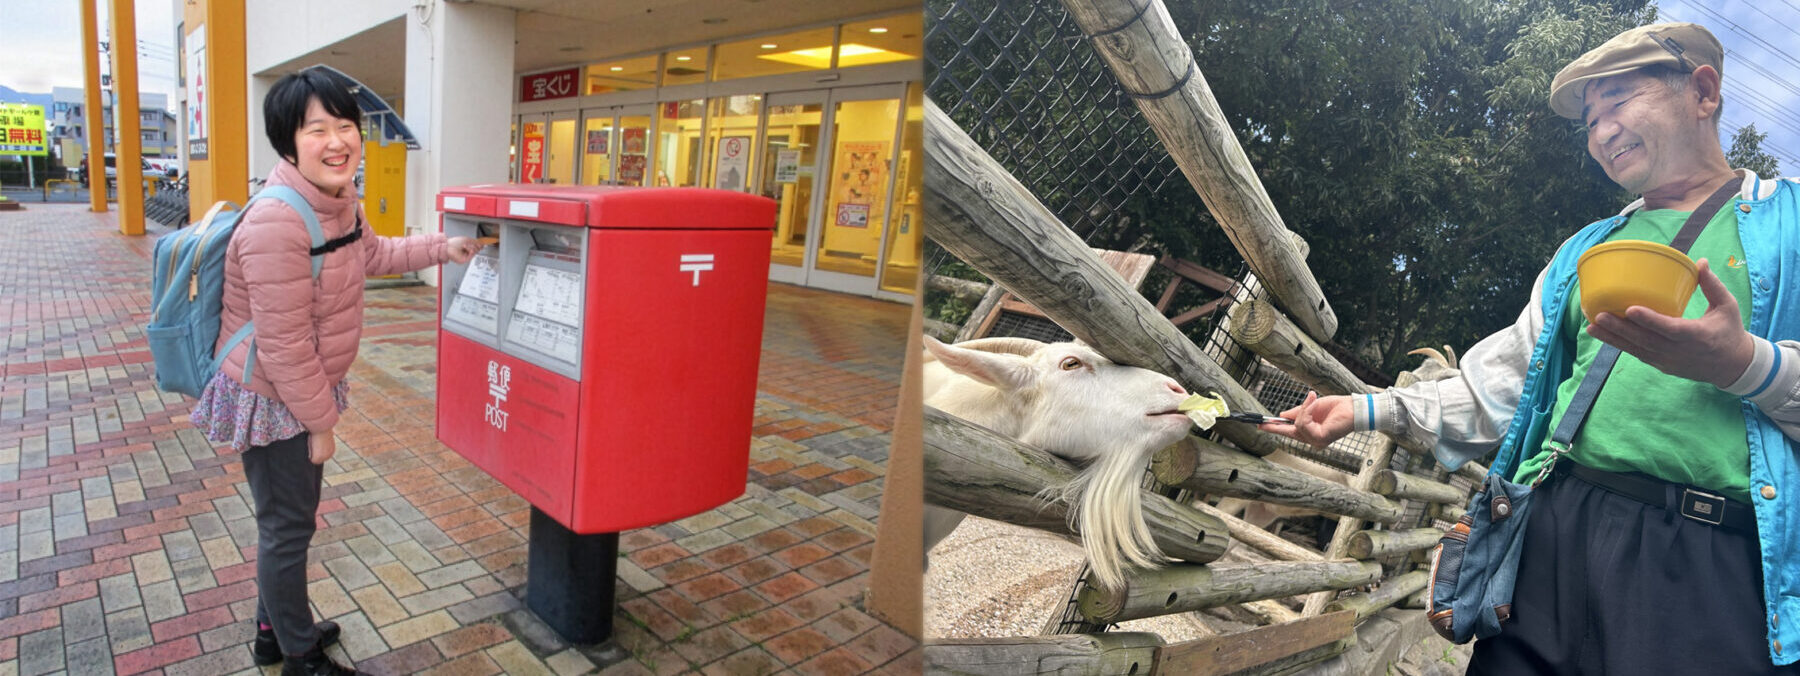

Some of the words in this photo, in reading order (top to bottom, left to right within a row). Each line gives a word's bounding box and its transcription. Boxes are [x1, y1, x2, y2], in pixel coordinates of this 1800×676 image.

[532, 75, 571, 98] 宝くじ
[487, 360, 511, 391] 郵便
[485, 403, 509, 432] POST
